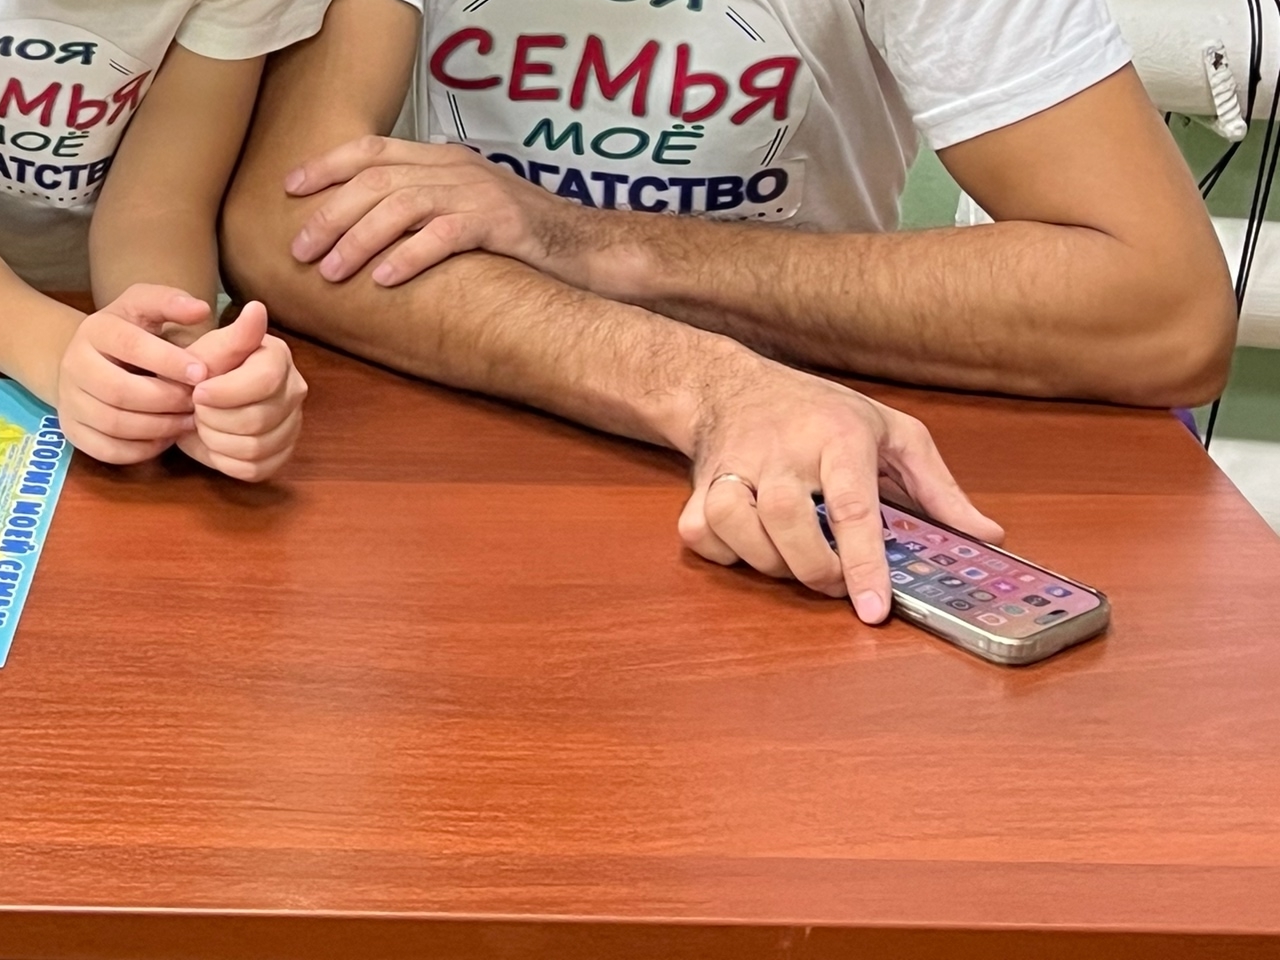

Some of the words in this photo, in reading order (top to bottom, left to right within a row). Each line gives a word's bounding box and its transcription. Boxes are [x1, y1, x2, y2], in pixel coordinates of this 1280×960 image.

[429, 26, 803, 126] СЕМЬЯ
[449, 141, 789, 215] ГАТСТВО
[522, 117, 706, 166] МОЁ
[18, 414, 66, 496] ИСТОРИЯ
